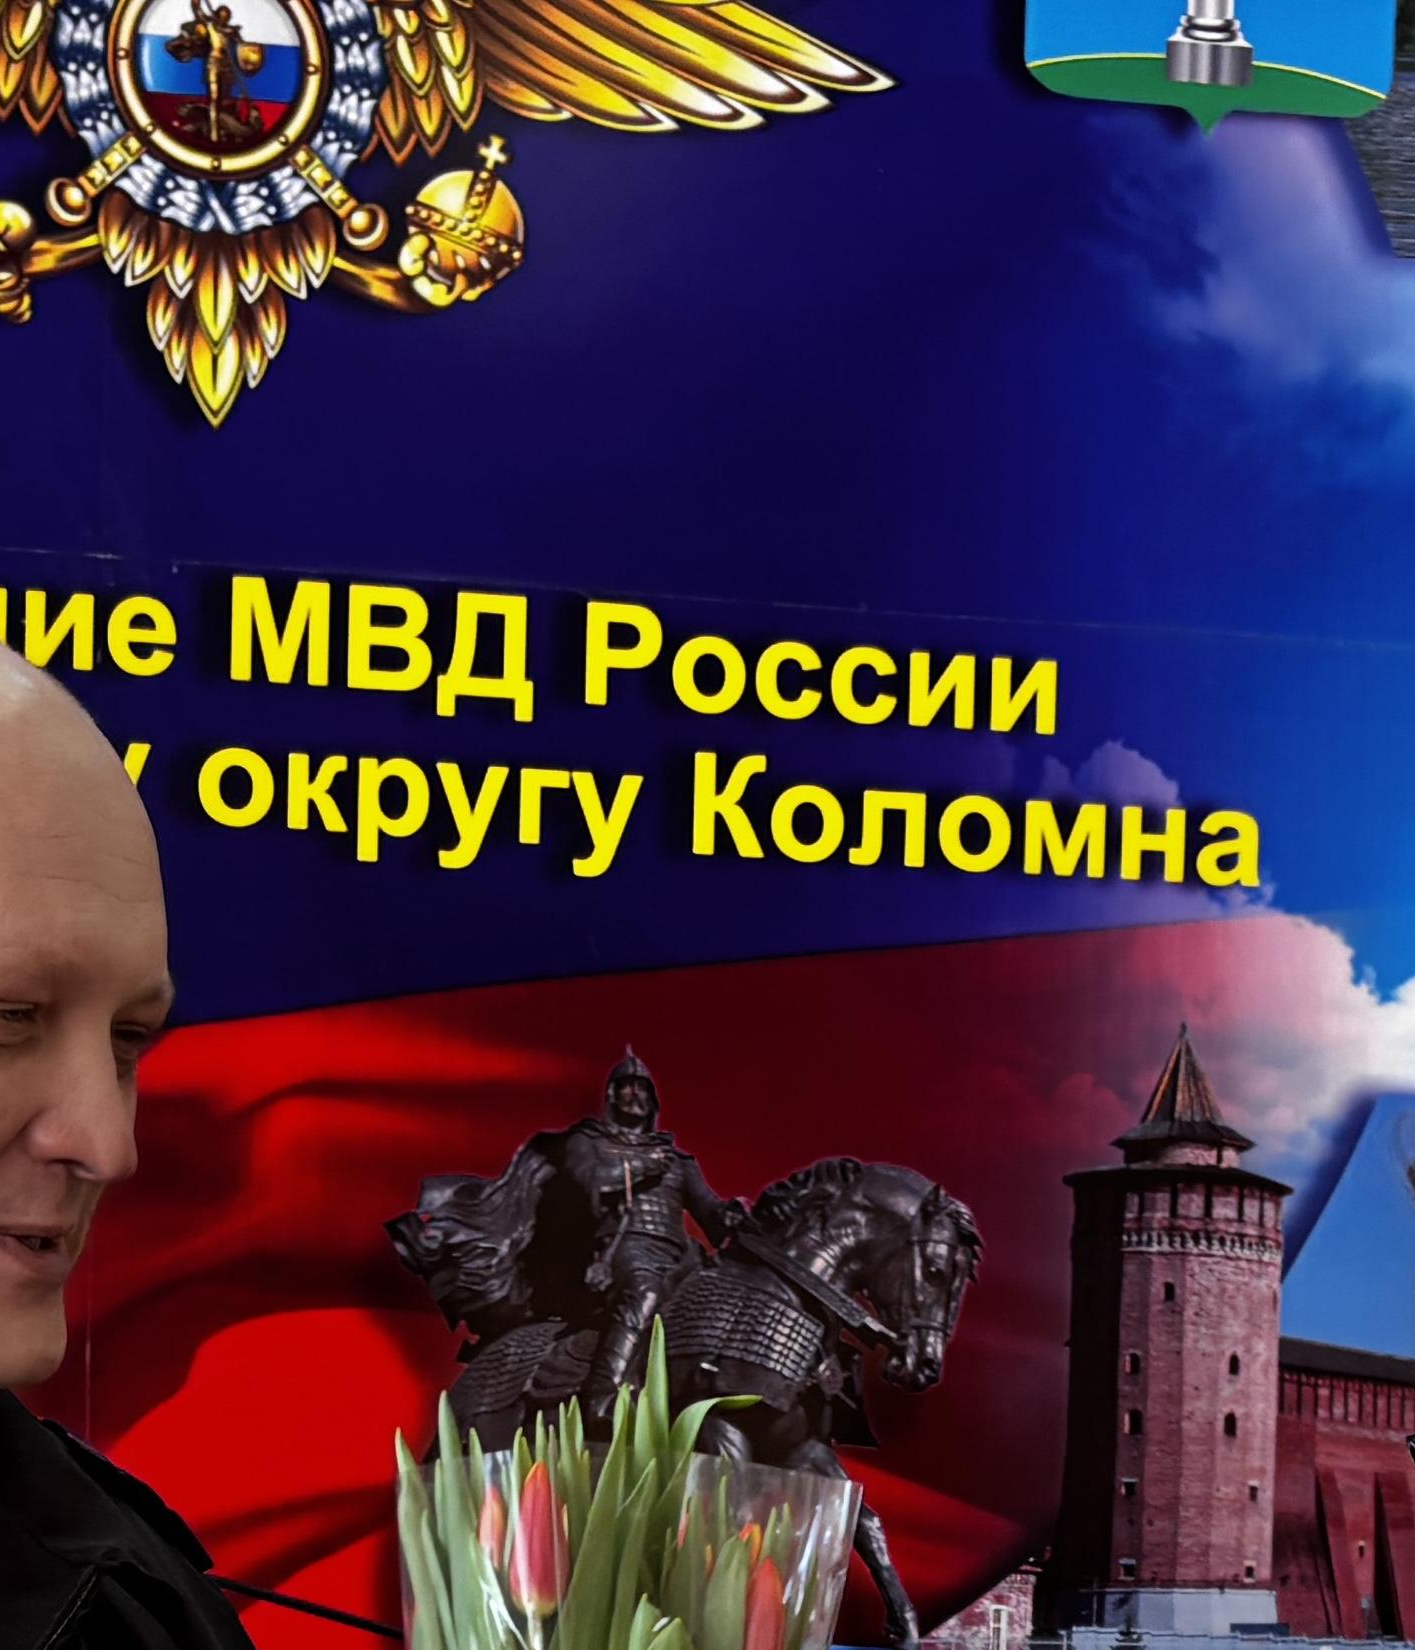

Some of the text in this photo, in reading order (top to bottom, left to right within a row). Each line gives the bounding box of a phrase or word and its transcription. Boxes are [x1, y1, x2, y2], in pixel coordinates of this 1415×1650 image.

[229, 574, 535, 724] МВД
[584, 599, 1059, 737] России
[198, 746, 645, 879] округу
[692, 750, 1261, 888] Коломна
